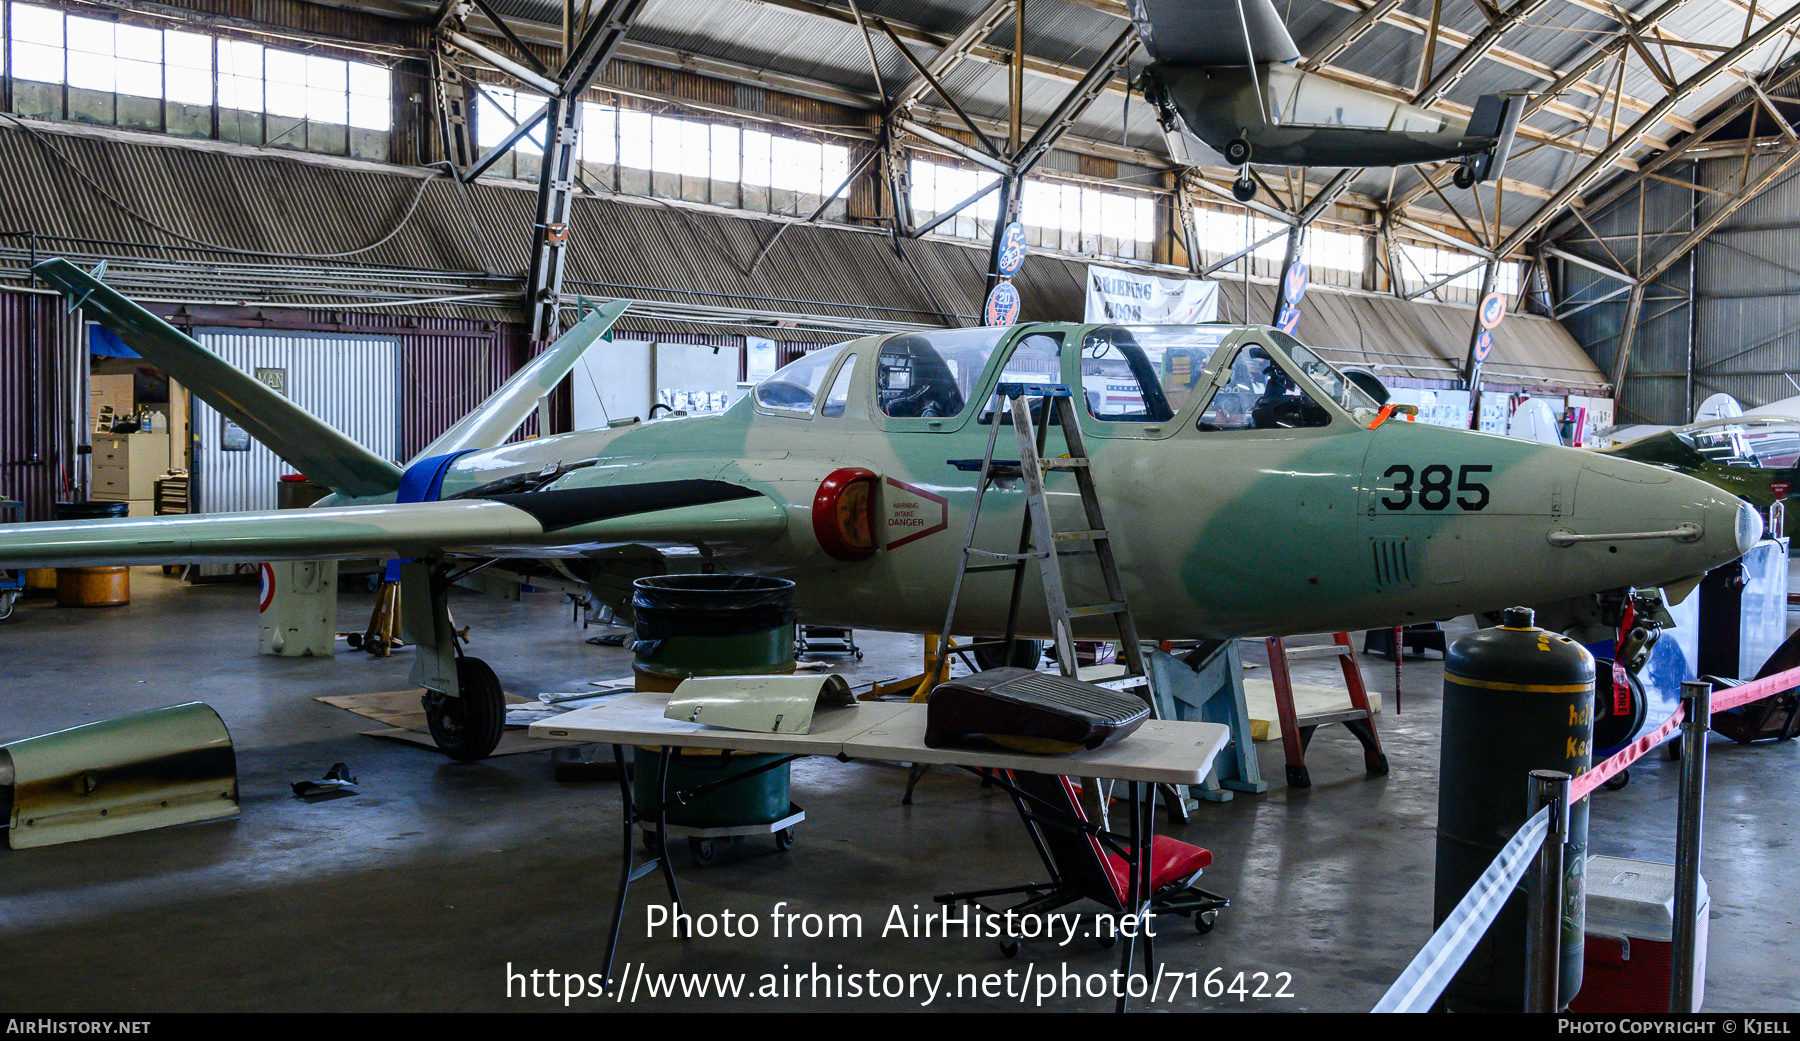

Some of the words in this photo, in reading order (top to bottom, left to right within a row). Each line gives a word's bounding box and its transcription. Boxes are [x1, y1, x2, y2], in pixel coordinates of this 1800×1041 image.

[998, 291, 1011, 305] 20
[257, 371, 285, 388] MAN
[1381, 464, 1493, 511] 385
[888, 518, 924, 526] DANGER
